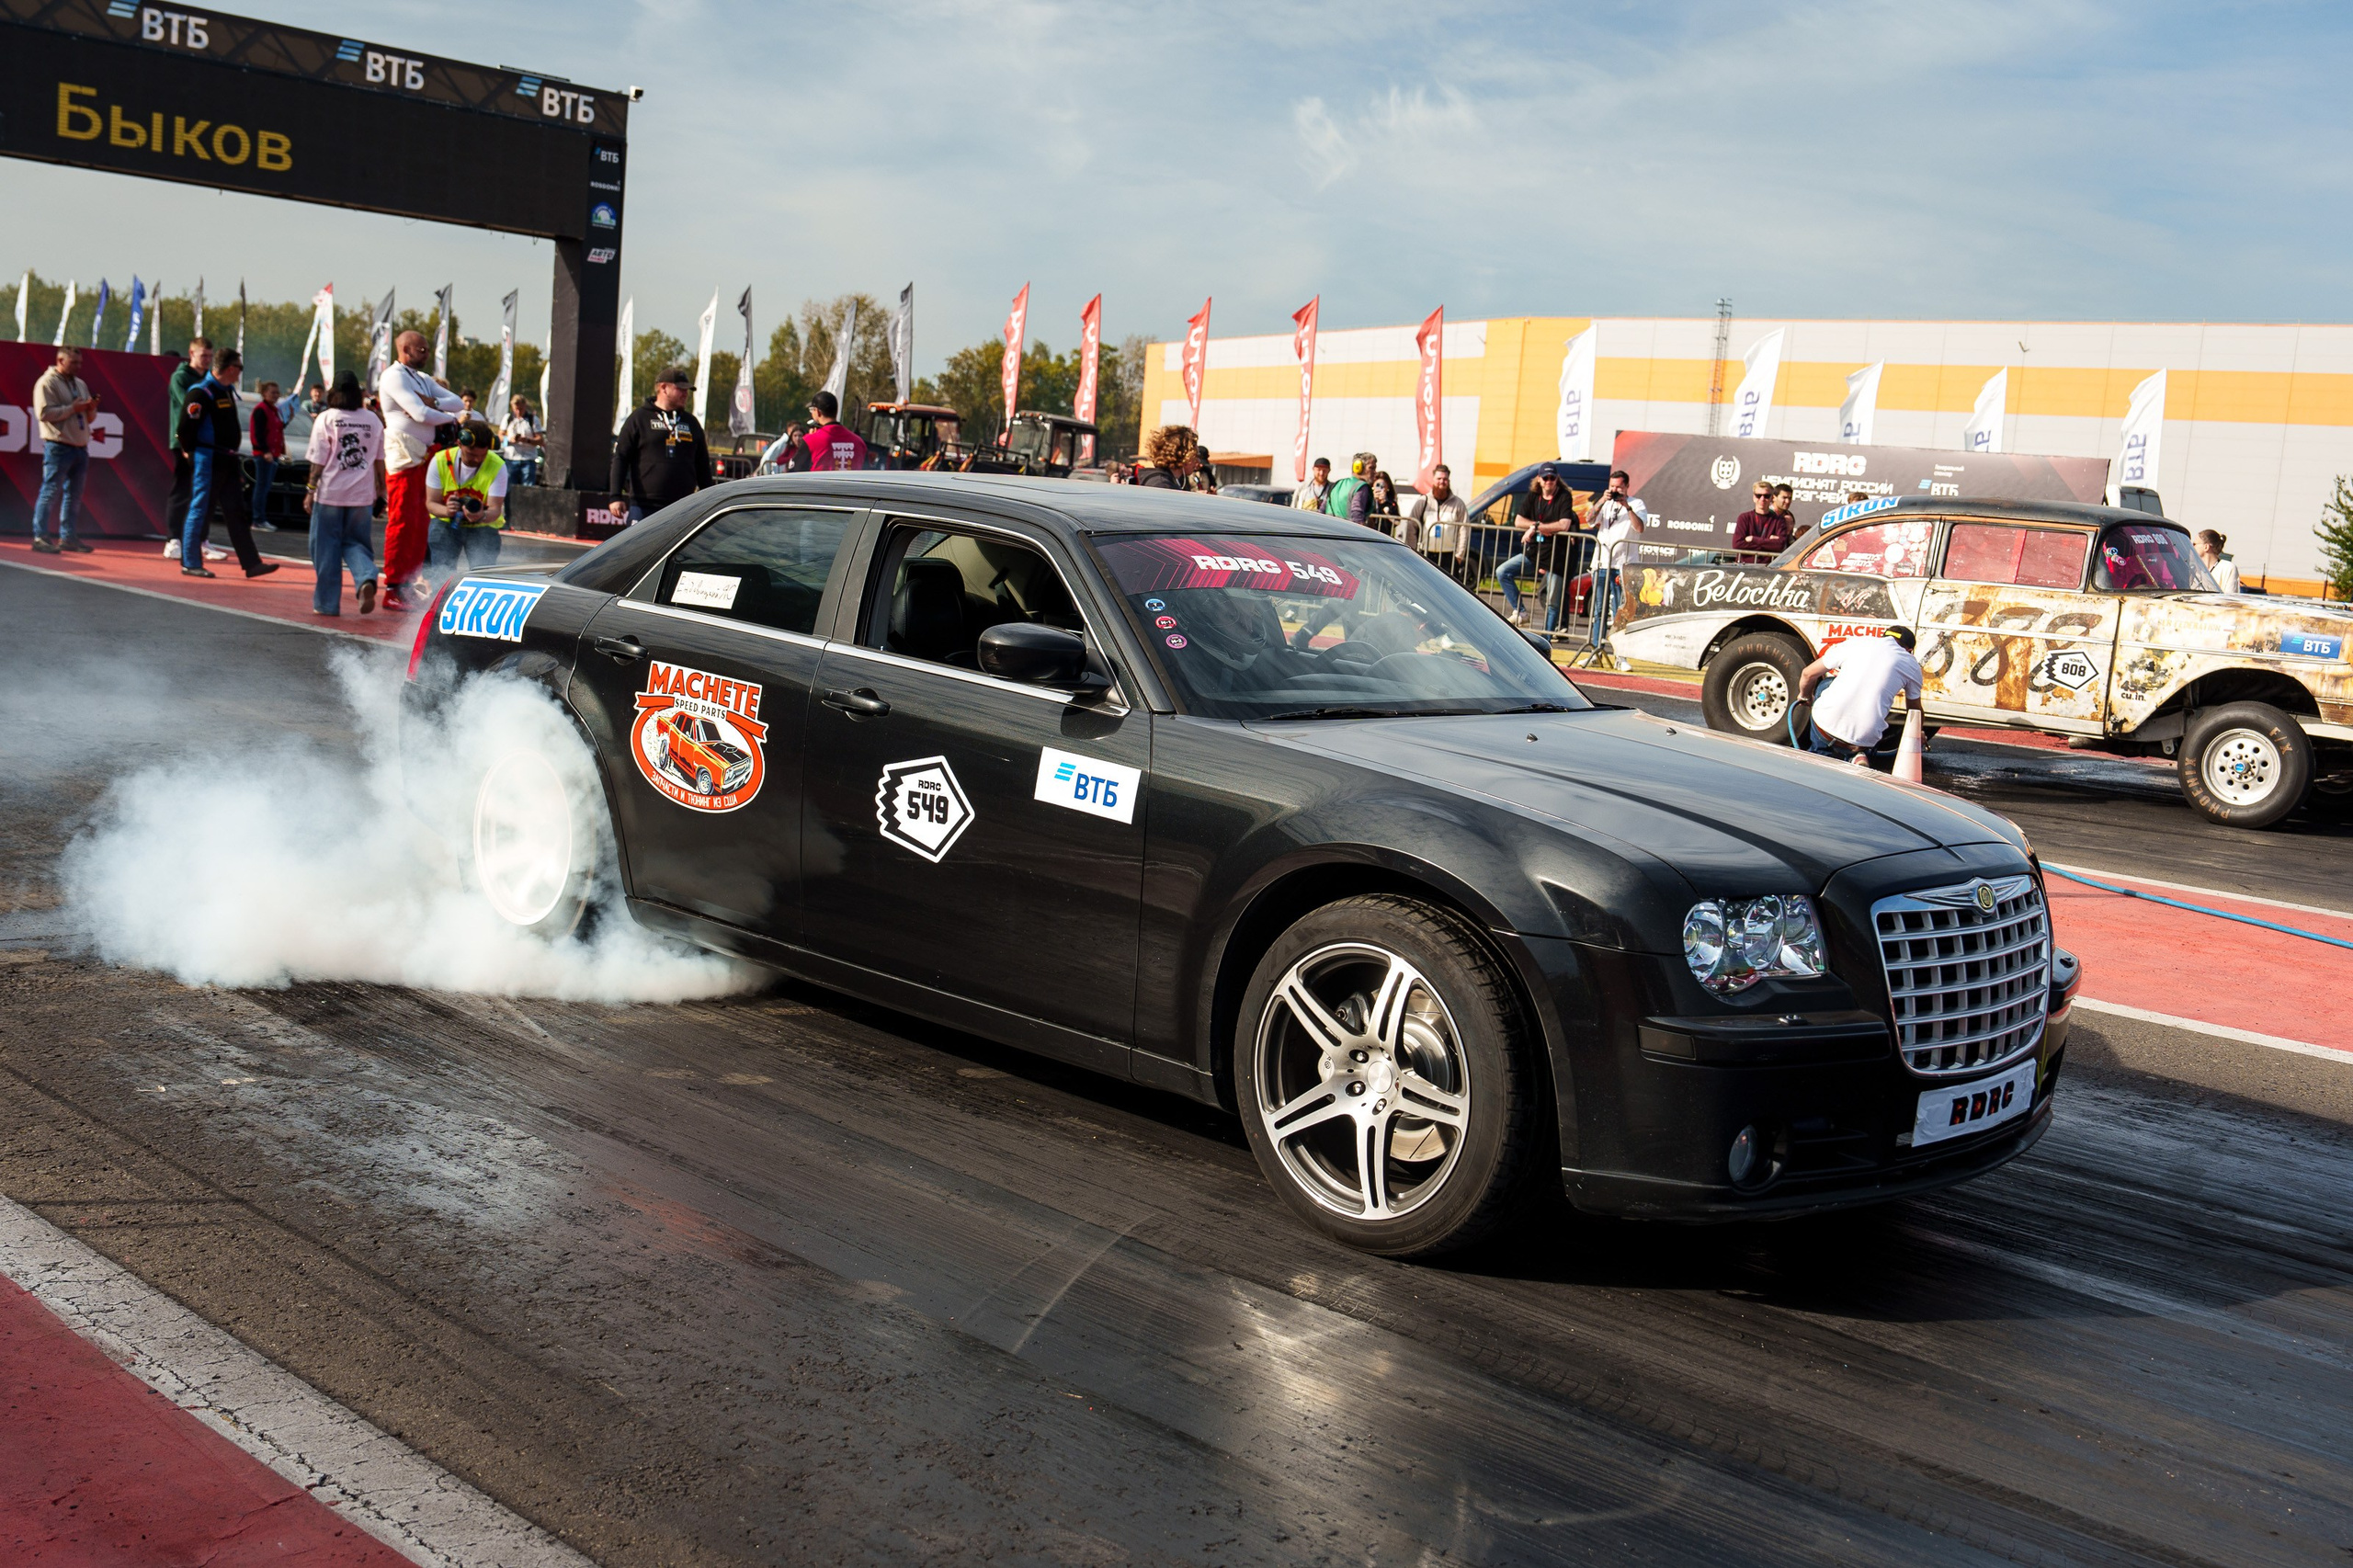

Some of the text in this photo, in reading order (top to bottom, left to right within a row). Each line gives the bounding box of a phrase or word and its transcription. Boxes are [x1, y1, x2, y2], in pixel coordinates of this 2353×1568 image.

[141, 8, 210, 50] ВТБ
[365, 51, 425, 91] ВТБ
[541, 86, 595, 124] ВТБ
[56, 82, 293, 172] Быков
[599, 151, 620, 164] ВТБ
[1792, 451, 1868, 476] RDRC
[1840, 480, 1894, 495] РОССИИ
[1930, 483, 1960, 496] ВТБ
[1645, 513, 1661, 528] ТБ
[1191, 555, 1343, 585] RDRC 549
[1692, 569, 1811, 608] Belochka
[441, 580, 545, 638] STRON
[1828, 624, 1888, 639] MACHE
[1737, 643, 1793, 668] PHOENIX
[2303, 639, 2331, 655] ВТБ
[2061, 662, 2086, 677] 808
[648, 663, 760, 720] MACHETE
[676, 699, 726, 720] SPEED PARTS
[2269, 726, 2293, 756] F/X
[651, 770, 738, 808] ЗАПЧАСТИ И ТЮНИНГ ИЗ США
[917, 779, 941, 791] RDRC
[1074, 773, 1119, 808] ВТБ
[2185, 756, 2232, 819] PHOENIX
[907, 790, 949, 824] 549
[1949, 1080, 2015, 1127] RDRC
